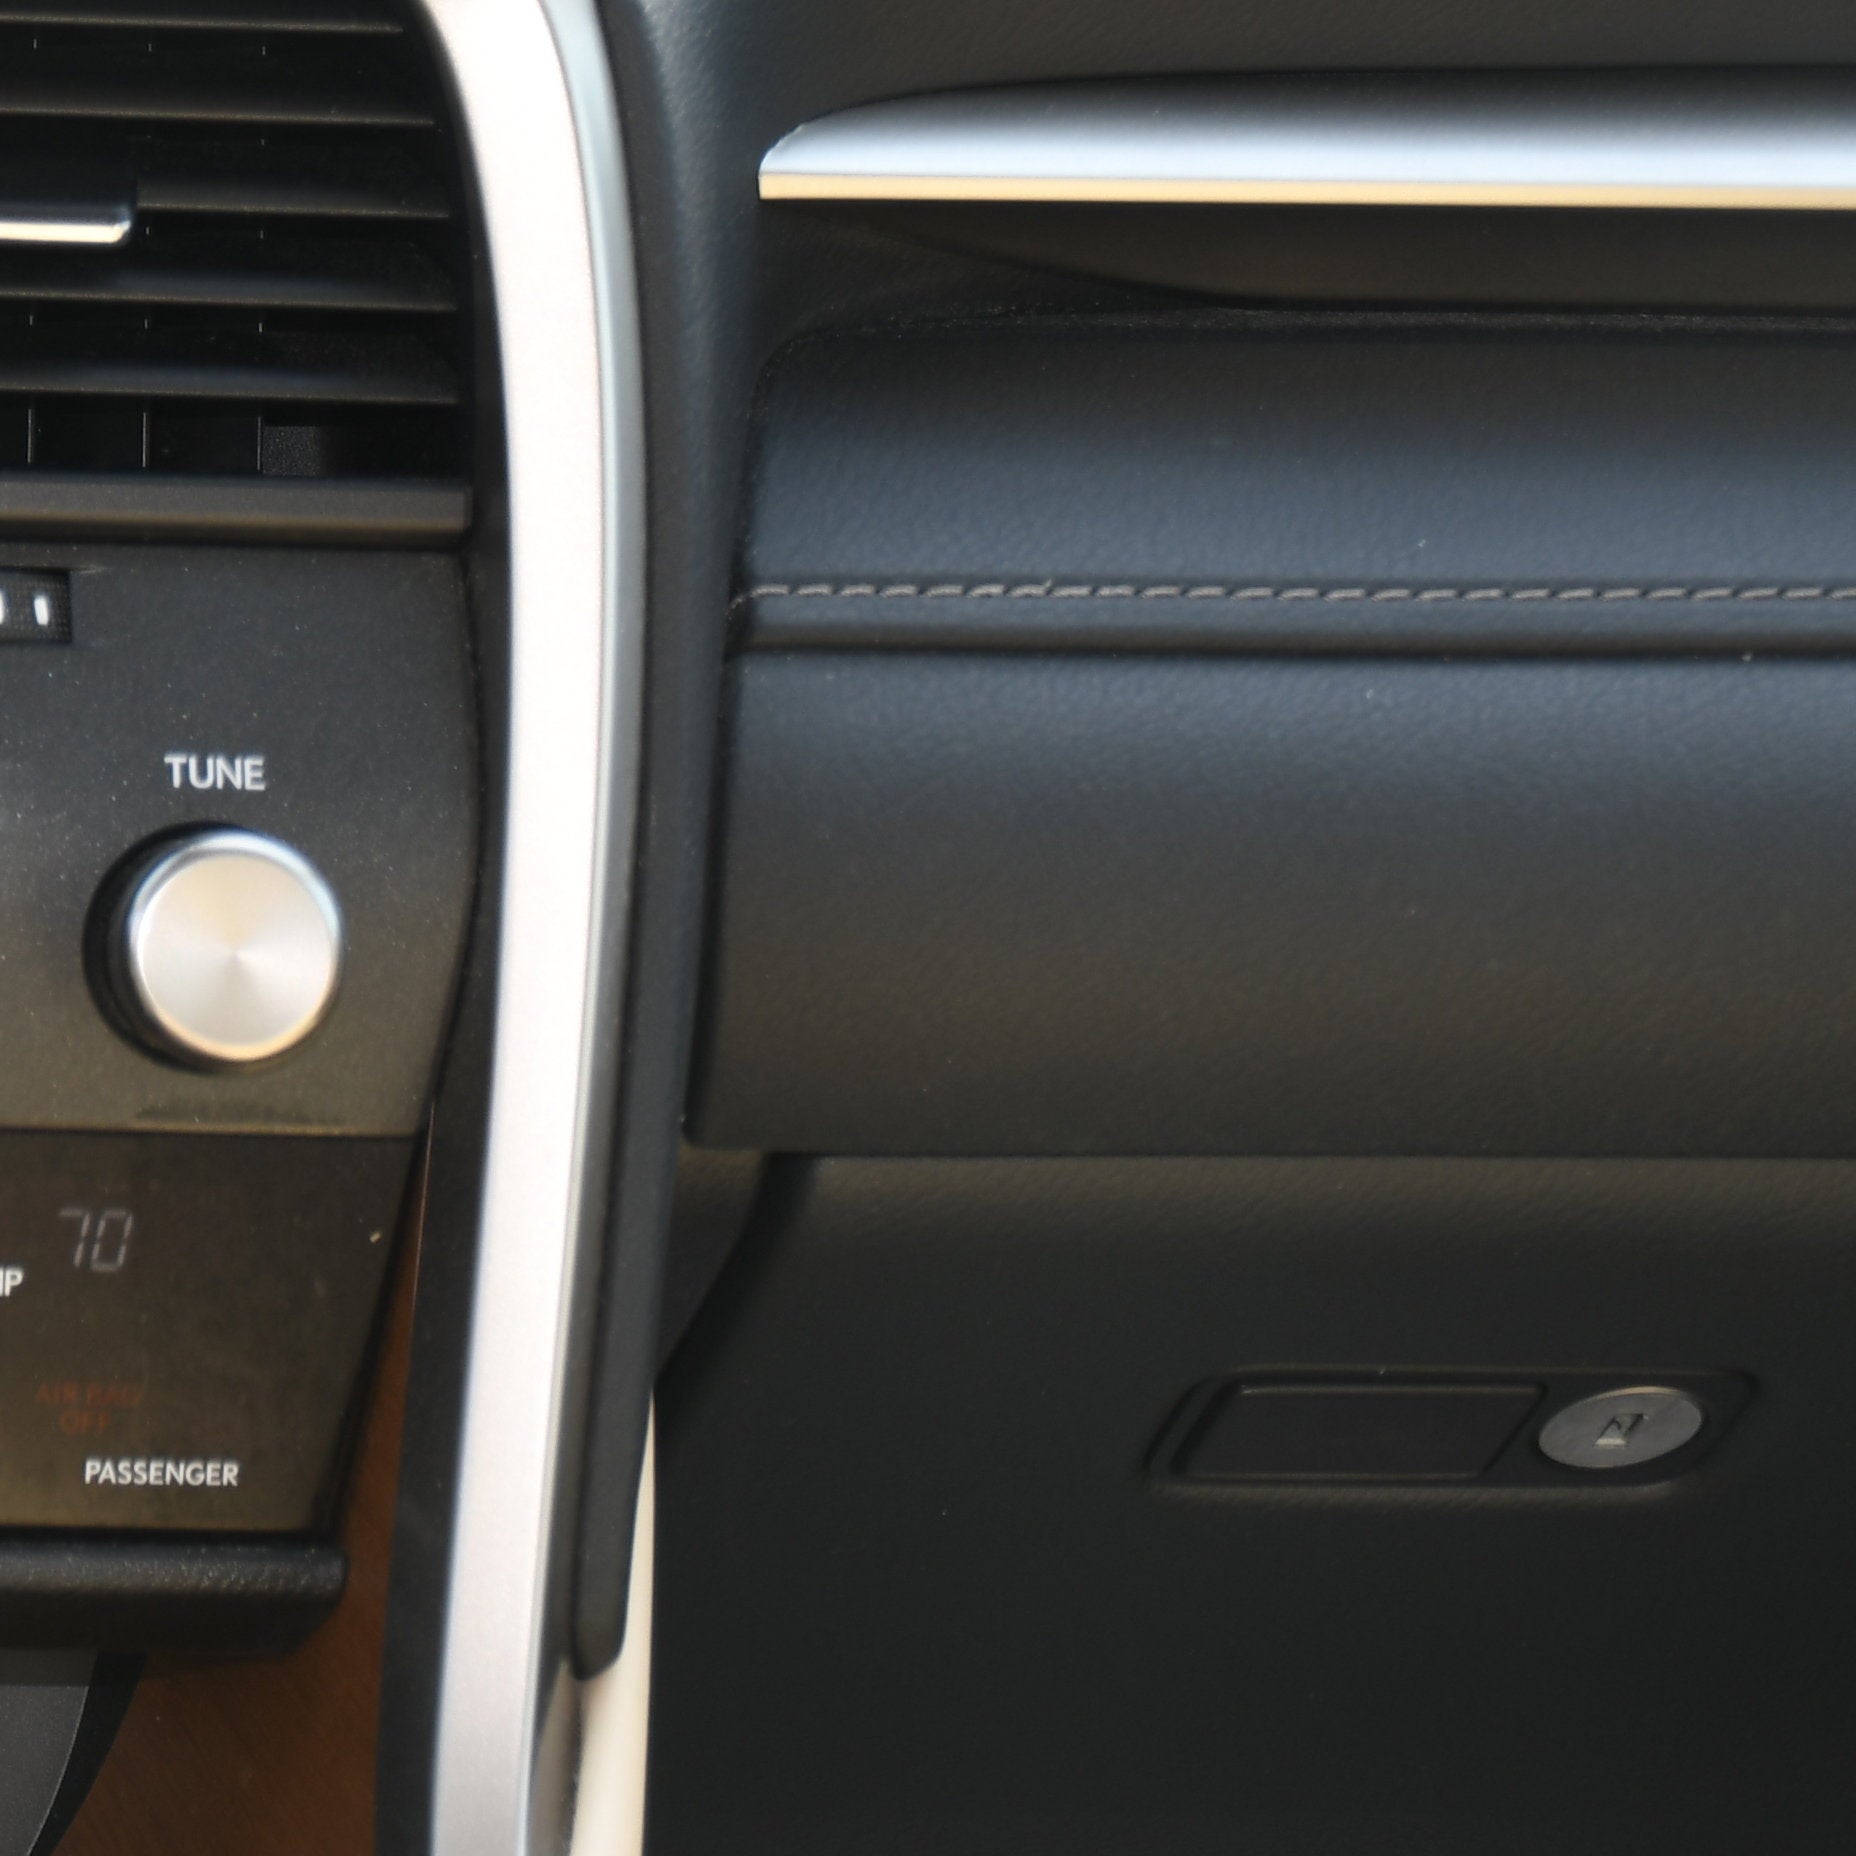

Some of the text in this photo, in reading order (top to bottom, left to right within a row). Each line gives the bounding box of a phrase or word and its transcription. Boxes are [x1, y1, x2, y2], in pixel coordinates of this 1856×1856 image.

[164, 751, 266, 792] TUNE
[59, 1208, 134, 1272] 70
[84, 1459, 239, 1489] PASSENGER
